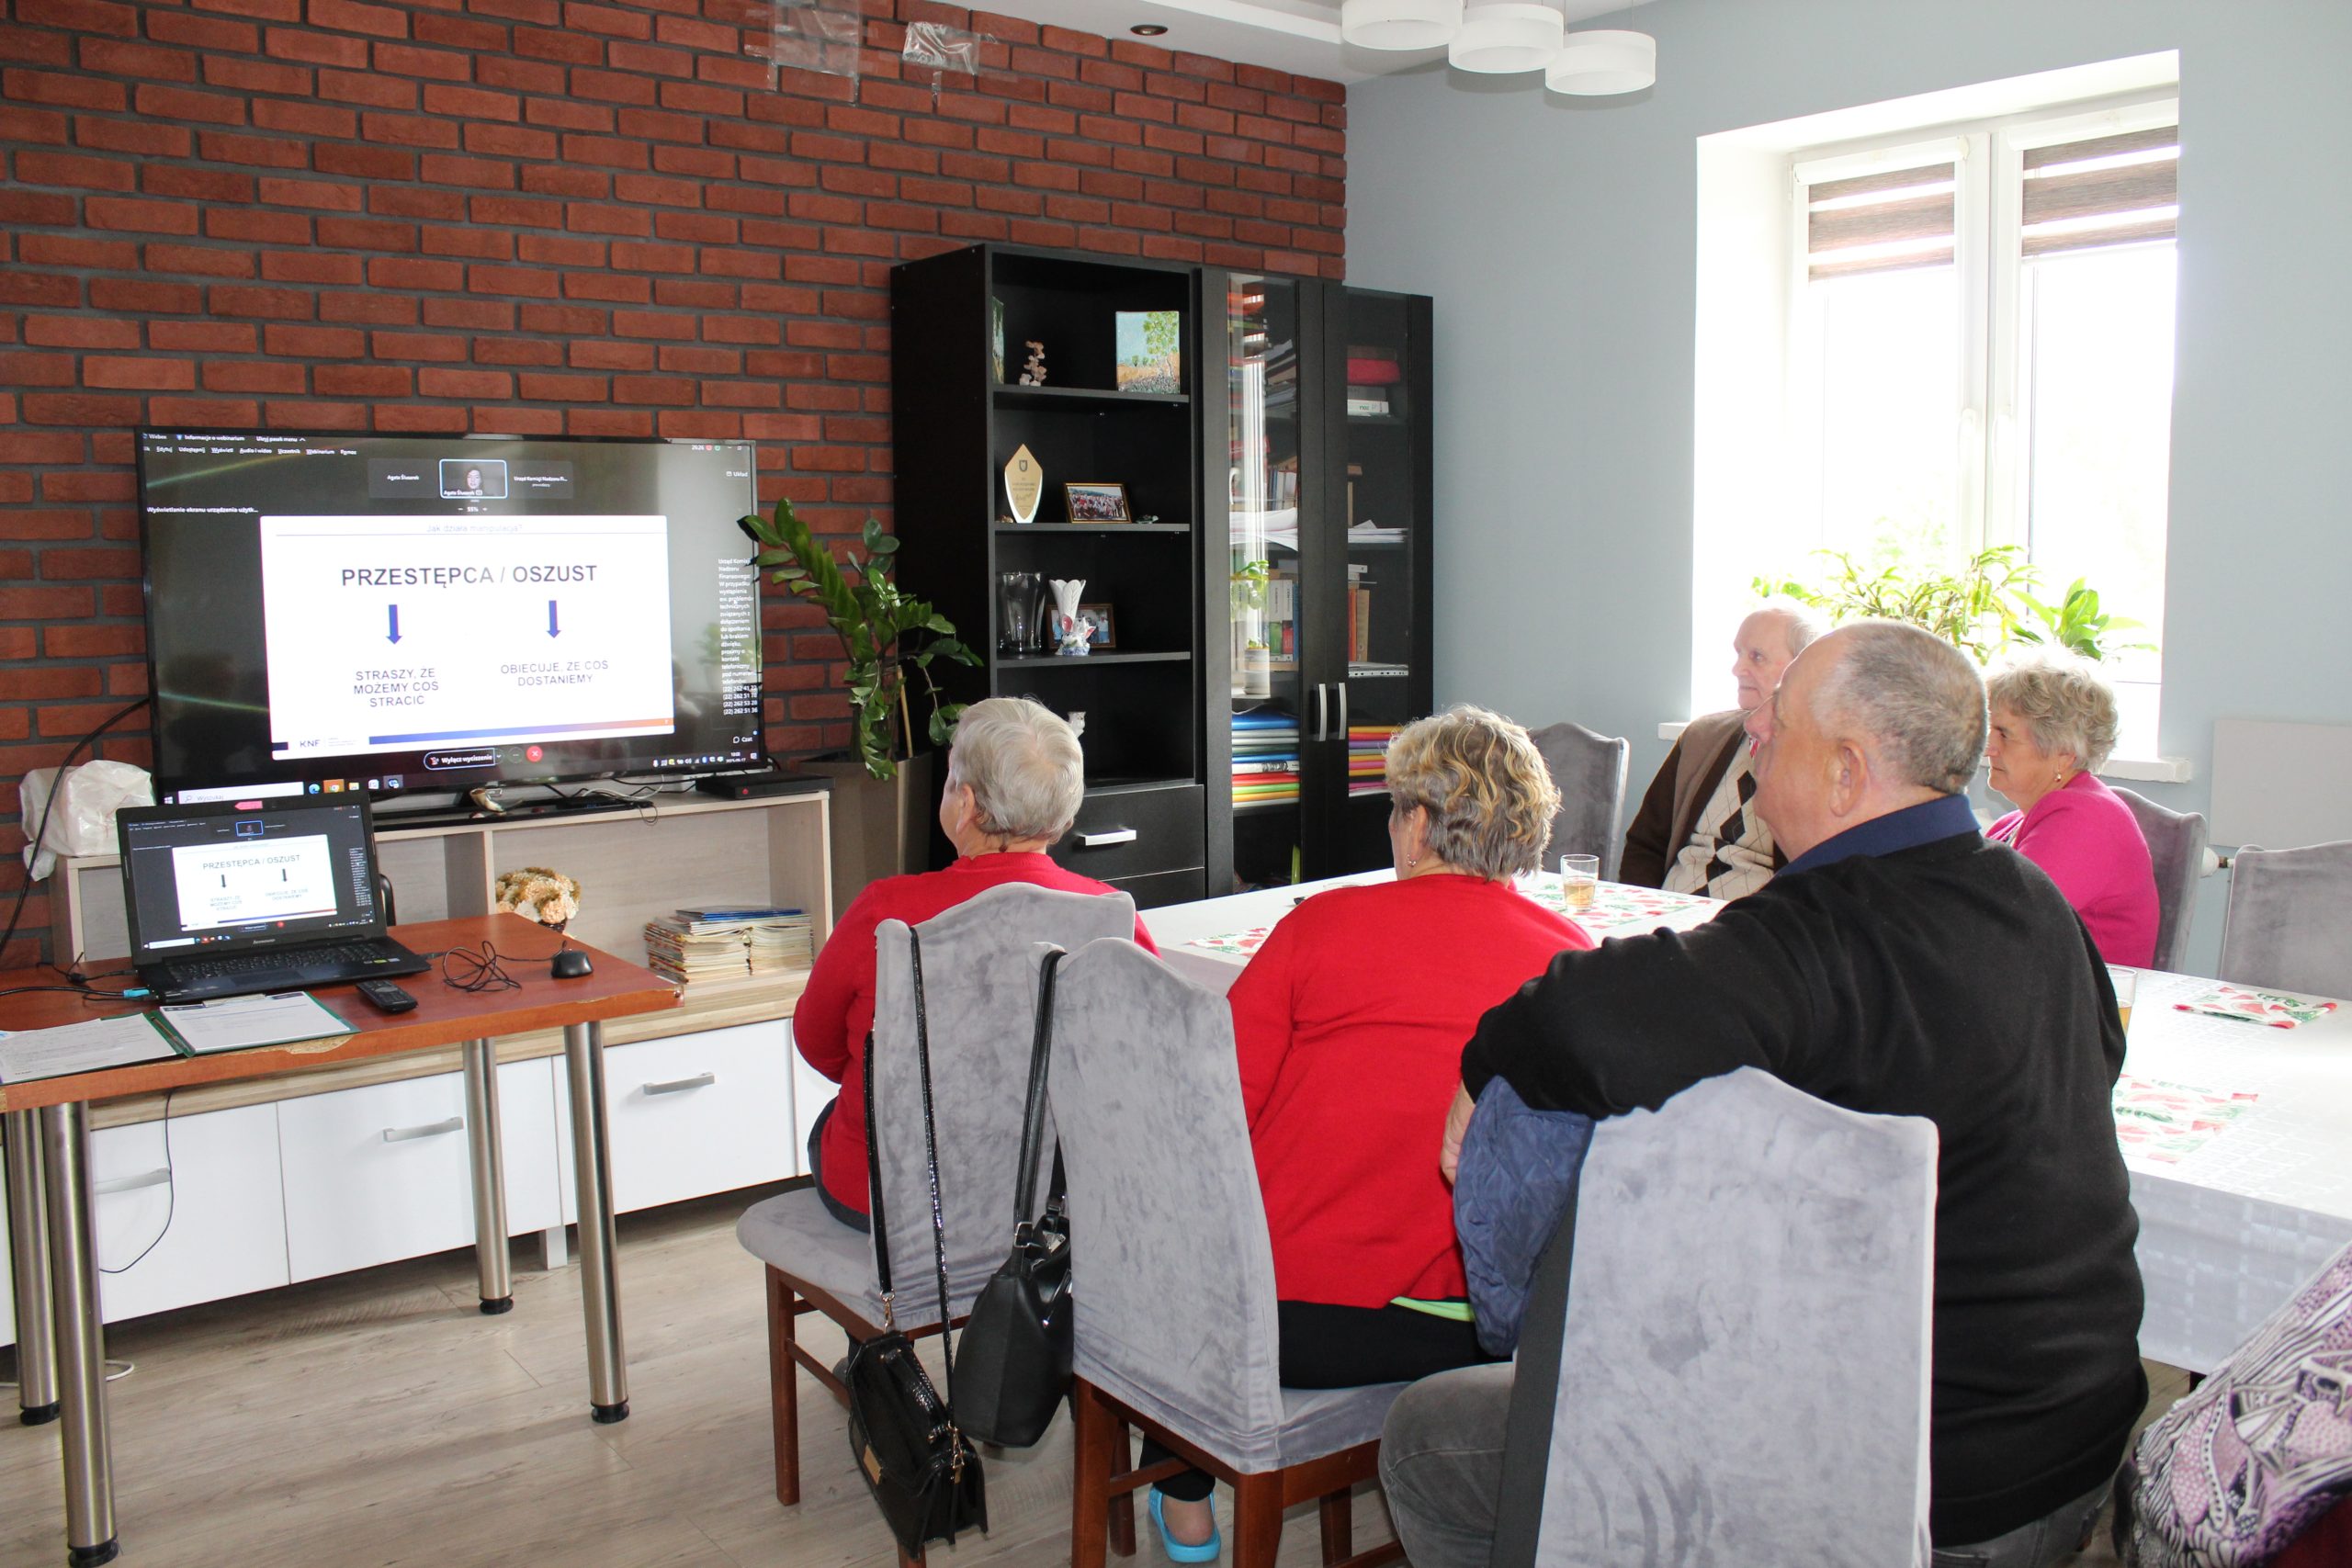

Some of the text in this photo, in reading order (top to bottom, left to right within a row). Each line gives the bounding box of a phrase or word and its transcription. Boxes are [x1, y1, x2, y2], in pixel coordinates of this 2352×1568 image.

[342, 565, 597, 589] PRZESTĘPCA / OSZUST
[517, 673, 593, 687] DOSTANIEMY
[354, 682, 407, 694] MOŻEMY
[300, 739, 321, 749] KNF
[441, 753, 492, 763] Wyłącz wyciszenie
[202, 858, 260, 871] PRZESTĘPCA
[266, 854, 301, 864] OSZUST
